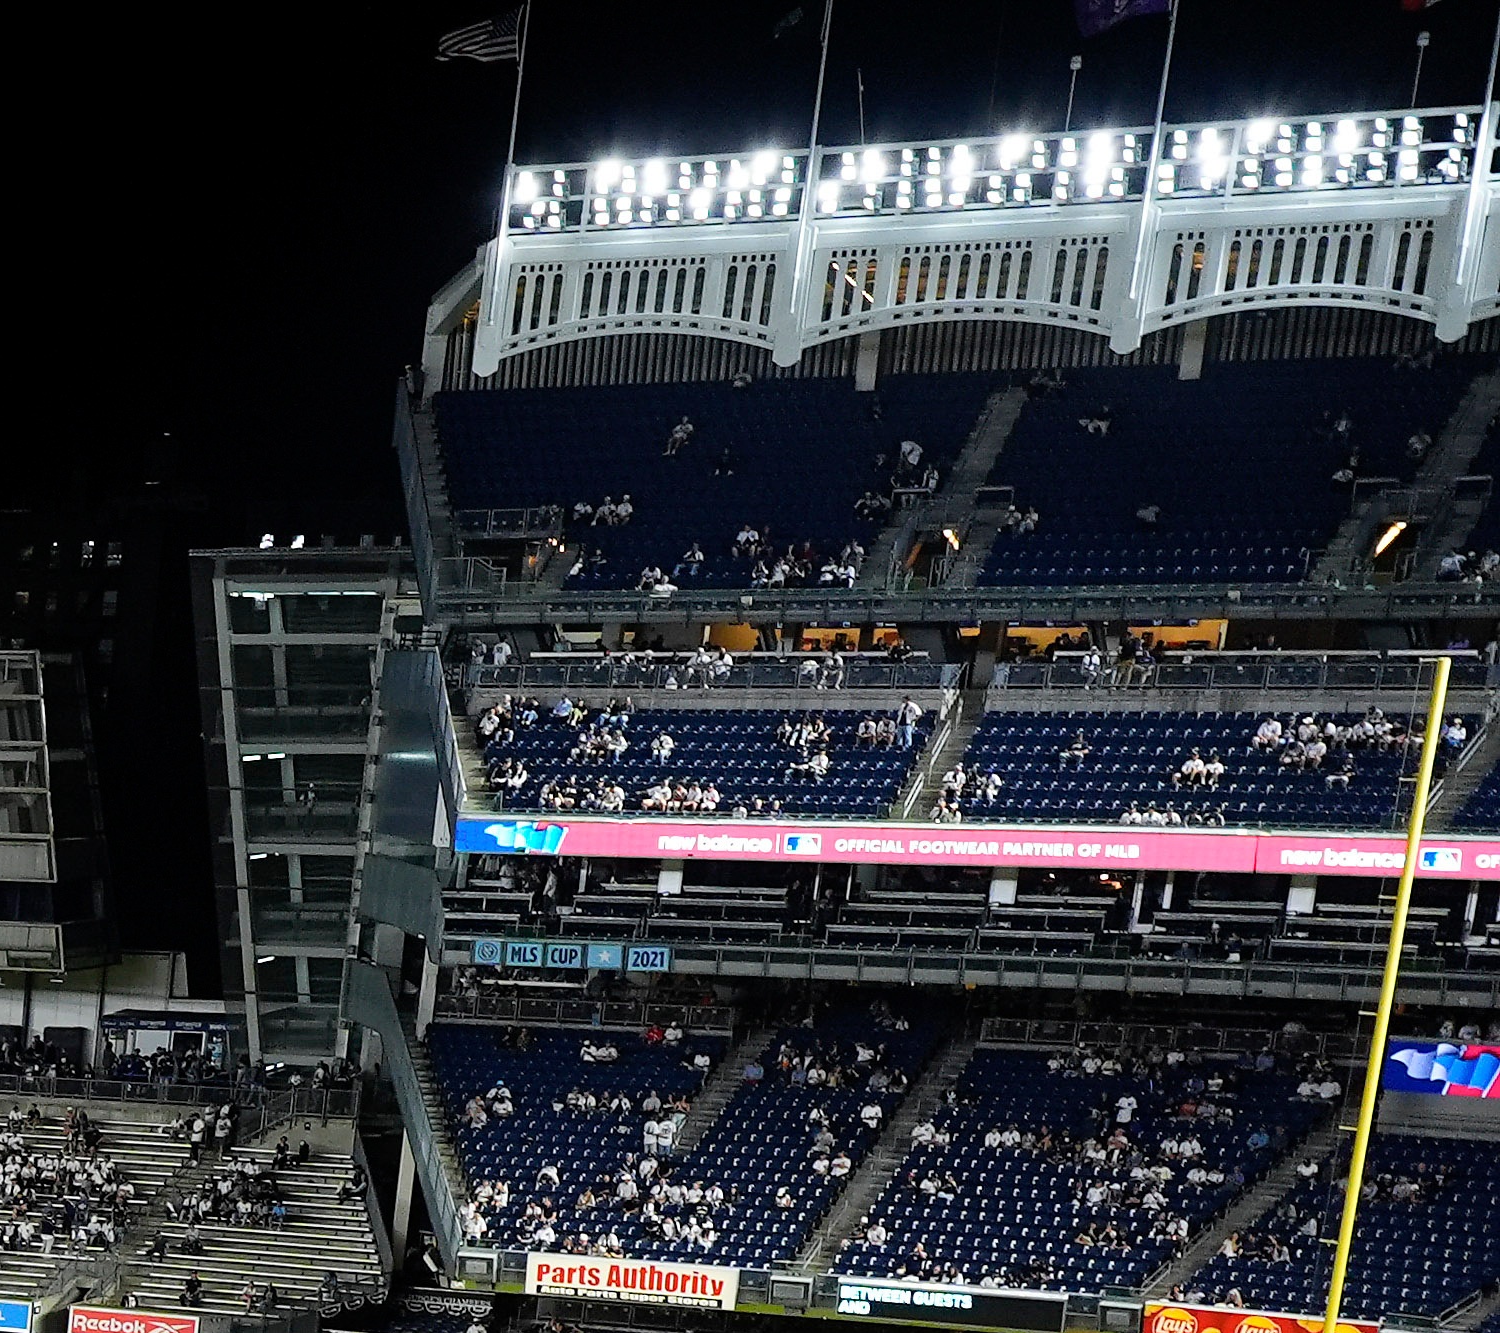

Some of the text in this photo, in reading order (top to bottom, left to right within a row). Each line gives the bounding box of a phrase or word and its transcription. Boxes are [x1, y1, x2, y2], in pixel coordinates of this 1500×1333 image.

[835, 839, 1140, 858] OFFICIAL FOOTWEAR PARTNER OF MLB
[511, 945, 665, 968] MLS CUP 2021
[537, 1264, 724, 1296] Parts Authority
